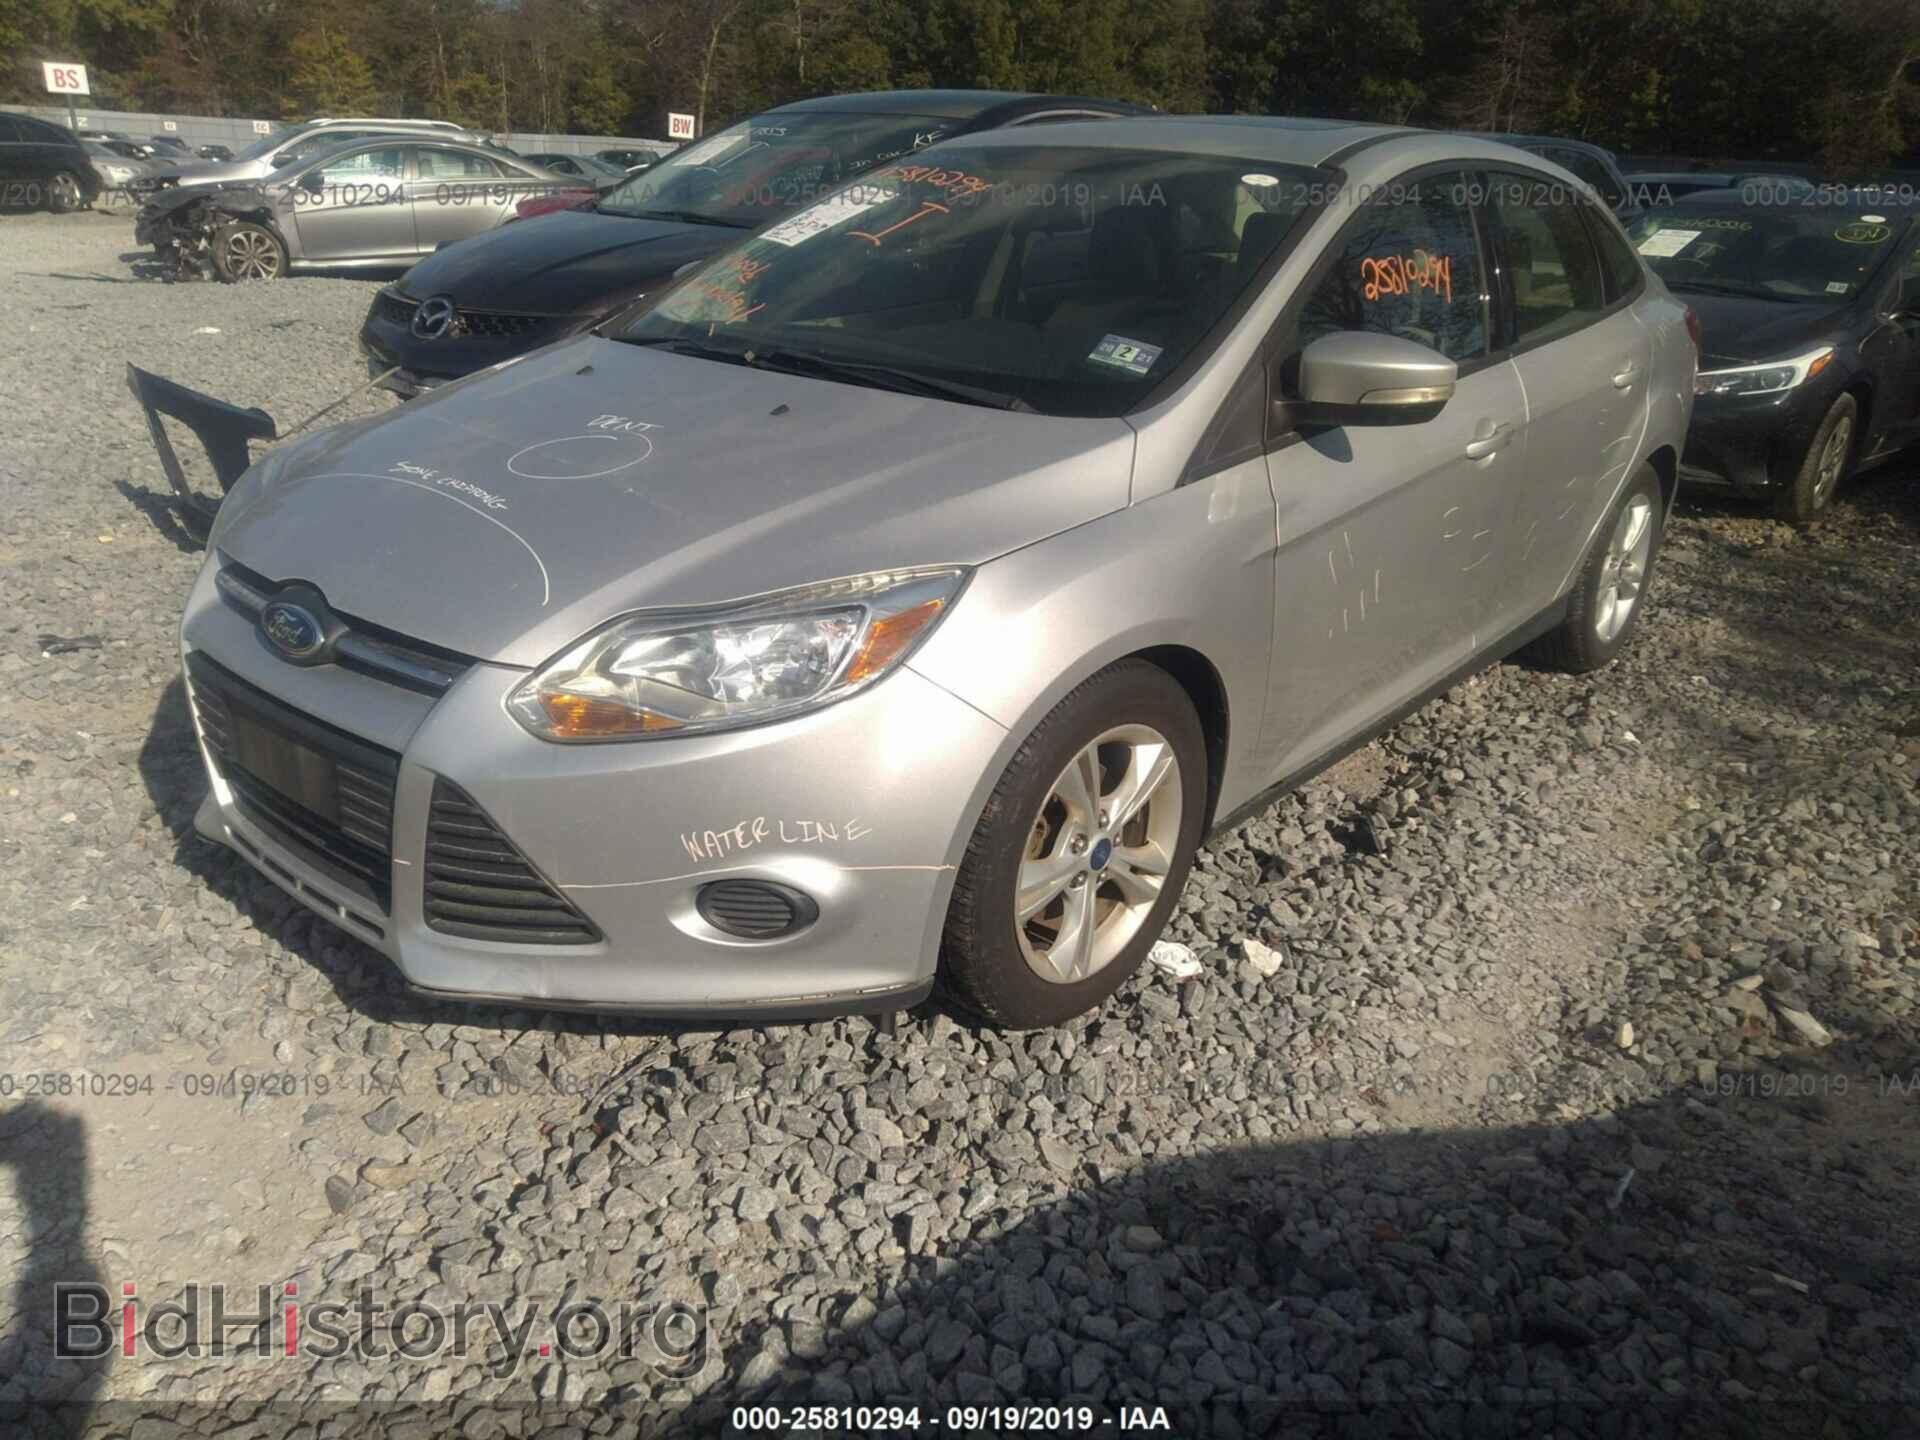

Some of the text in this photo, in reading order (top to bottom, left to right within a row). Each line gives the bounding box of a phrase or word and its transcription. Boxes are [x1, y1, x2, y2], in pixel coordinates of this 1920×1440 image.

[52, 67, 80, 89] BS
[672, 117, 692, 134] BW
[680, 816, 873, 863] WATER LINE
